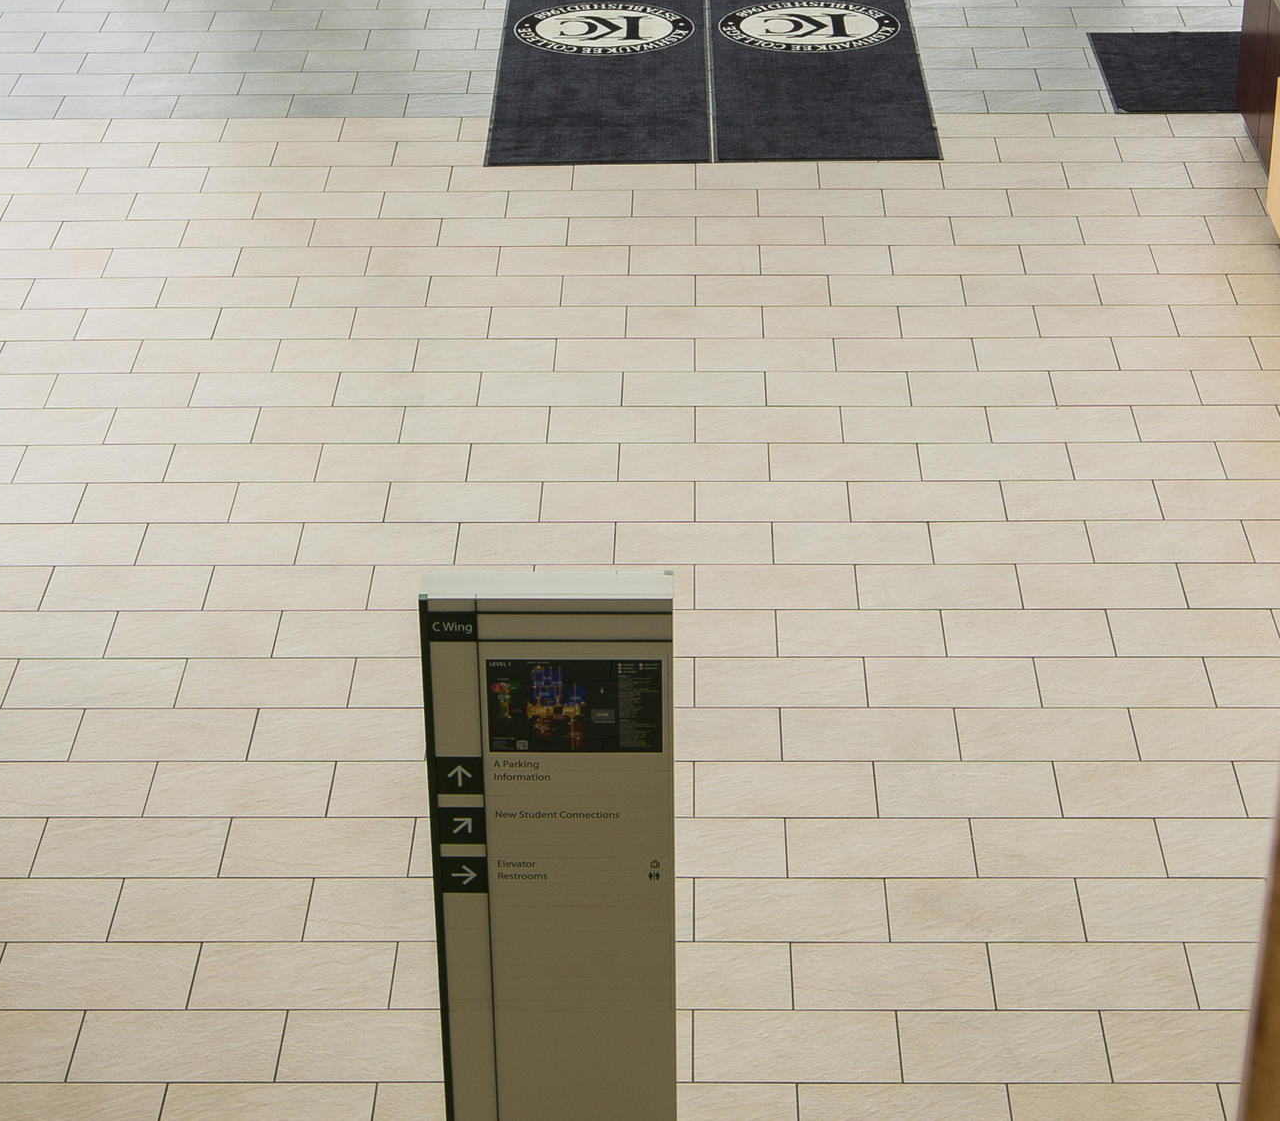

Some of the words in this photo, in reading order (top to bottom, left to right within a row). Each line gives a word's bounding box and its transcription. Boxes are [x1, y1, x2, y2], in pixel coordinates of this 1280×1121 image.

[559, 16, 646, 41] KC
[764, 13, 851, 38] KC
[518, 28, 577, 53] COLLEGE
[582, 29, 689, 55] KISHWAUKEE
[722, 25, 783, 51] COLLEGE
[792, 26, 896, 52] KISHWAUKEE
[432, 622, 441, 632] C
[442, 621, 473, 635] Wing
[493, 760, 501, 768] A
[502, 759, 540, 771] Parking
[493, 772, 551, 781] Information
[495, 810, 517, 819] New
[519, 809, 558, 819] Student
[559, 810, 620, 819] Connections
[497, 859, 536, 868] Elevator
[497, 872, 548, 880] Restrooms
